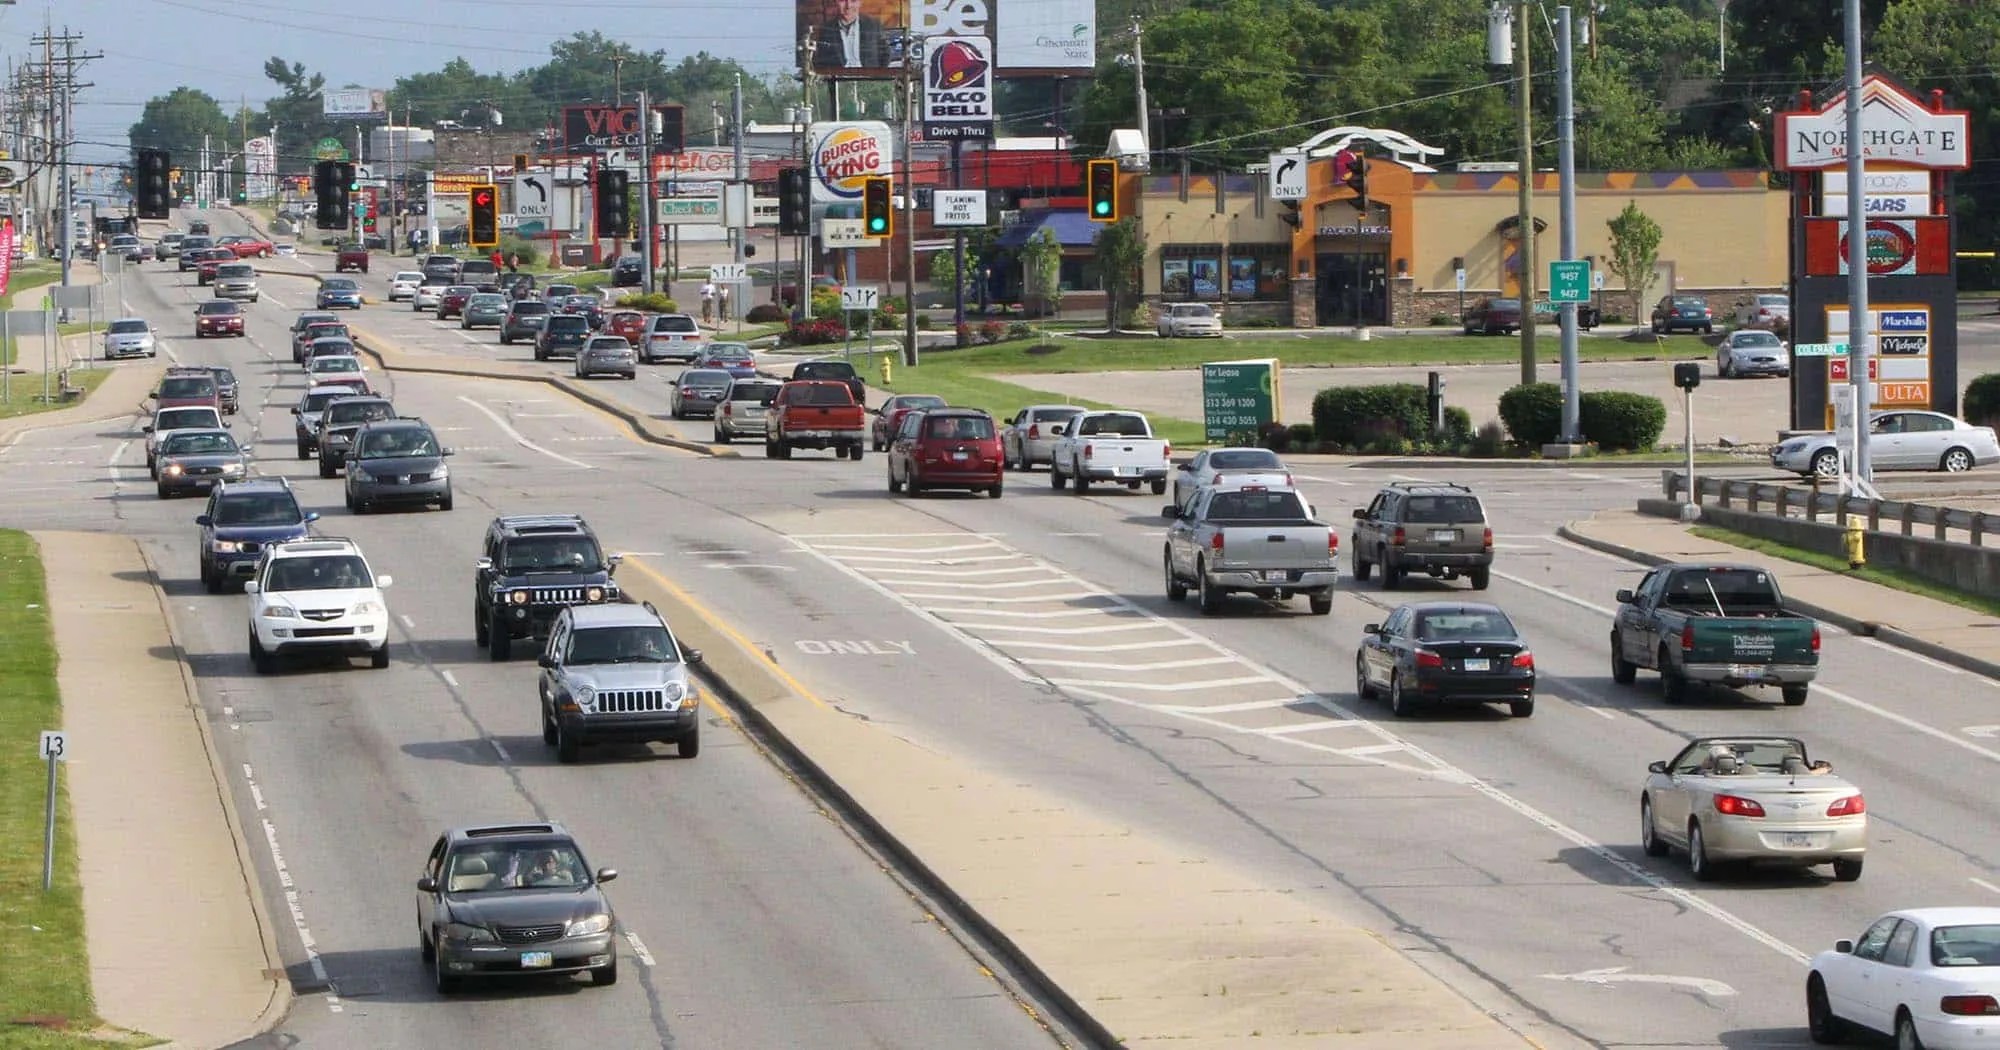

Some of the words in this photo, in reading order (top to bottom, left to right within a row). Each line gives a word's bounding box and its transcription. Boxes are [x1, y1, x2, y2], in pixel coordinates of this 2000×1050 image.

[928, 92, 986, 103] TACO
[932, 105, 987, 116] BELL
[931, 126, 959, 136] Drive
[961, 126, 986, 136] Thru
[821, 136, 877, 166] BURGER
[825, 151, 880, 185] KING
[1275, 186, 1303, 196] ONLY
[945, 195, 977, 204] FLAMING
[520, 205, 548, 214] ONLY
[1882, 316, 1926, 327] Marshalls
[1204, 367, 1217, 377] For
[1218, 367, 1241, 377] Lease
[1884, 385, 1924, 400] ULTA
[794, 640, 918, 655] ONLY
[45, 735, 64, 756] 13
